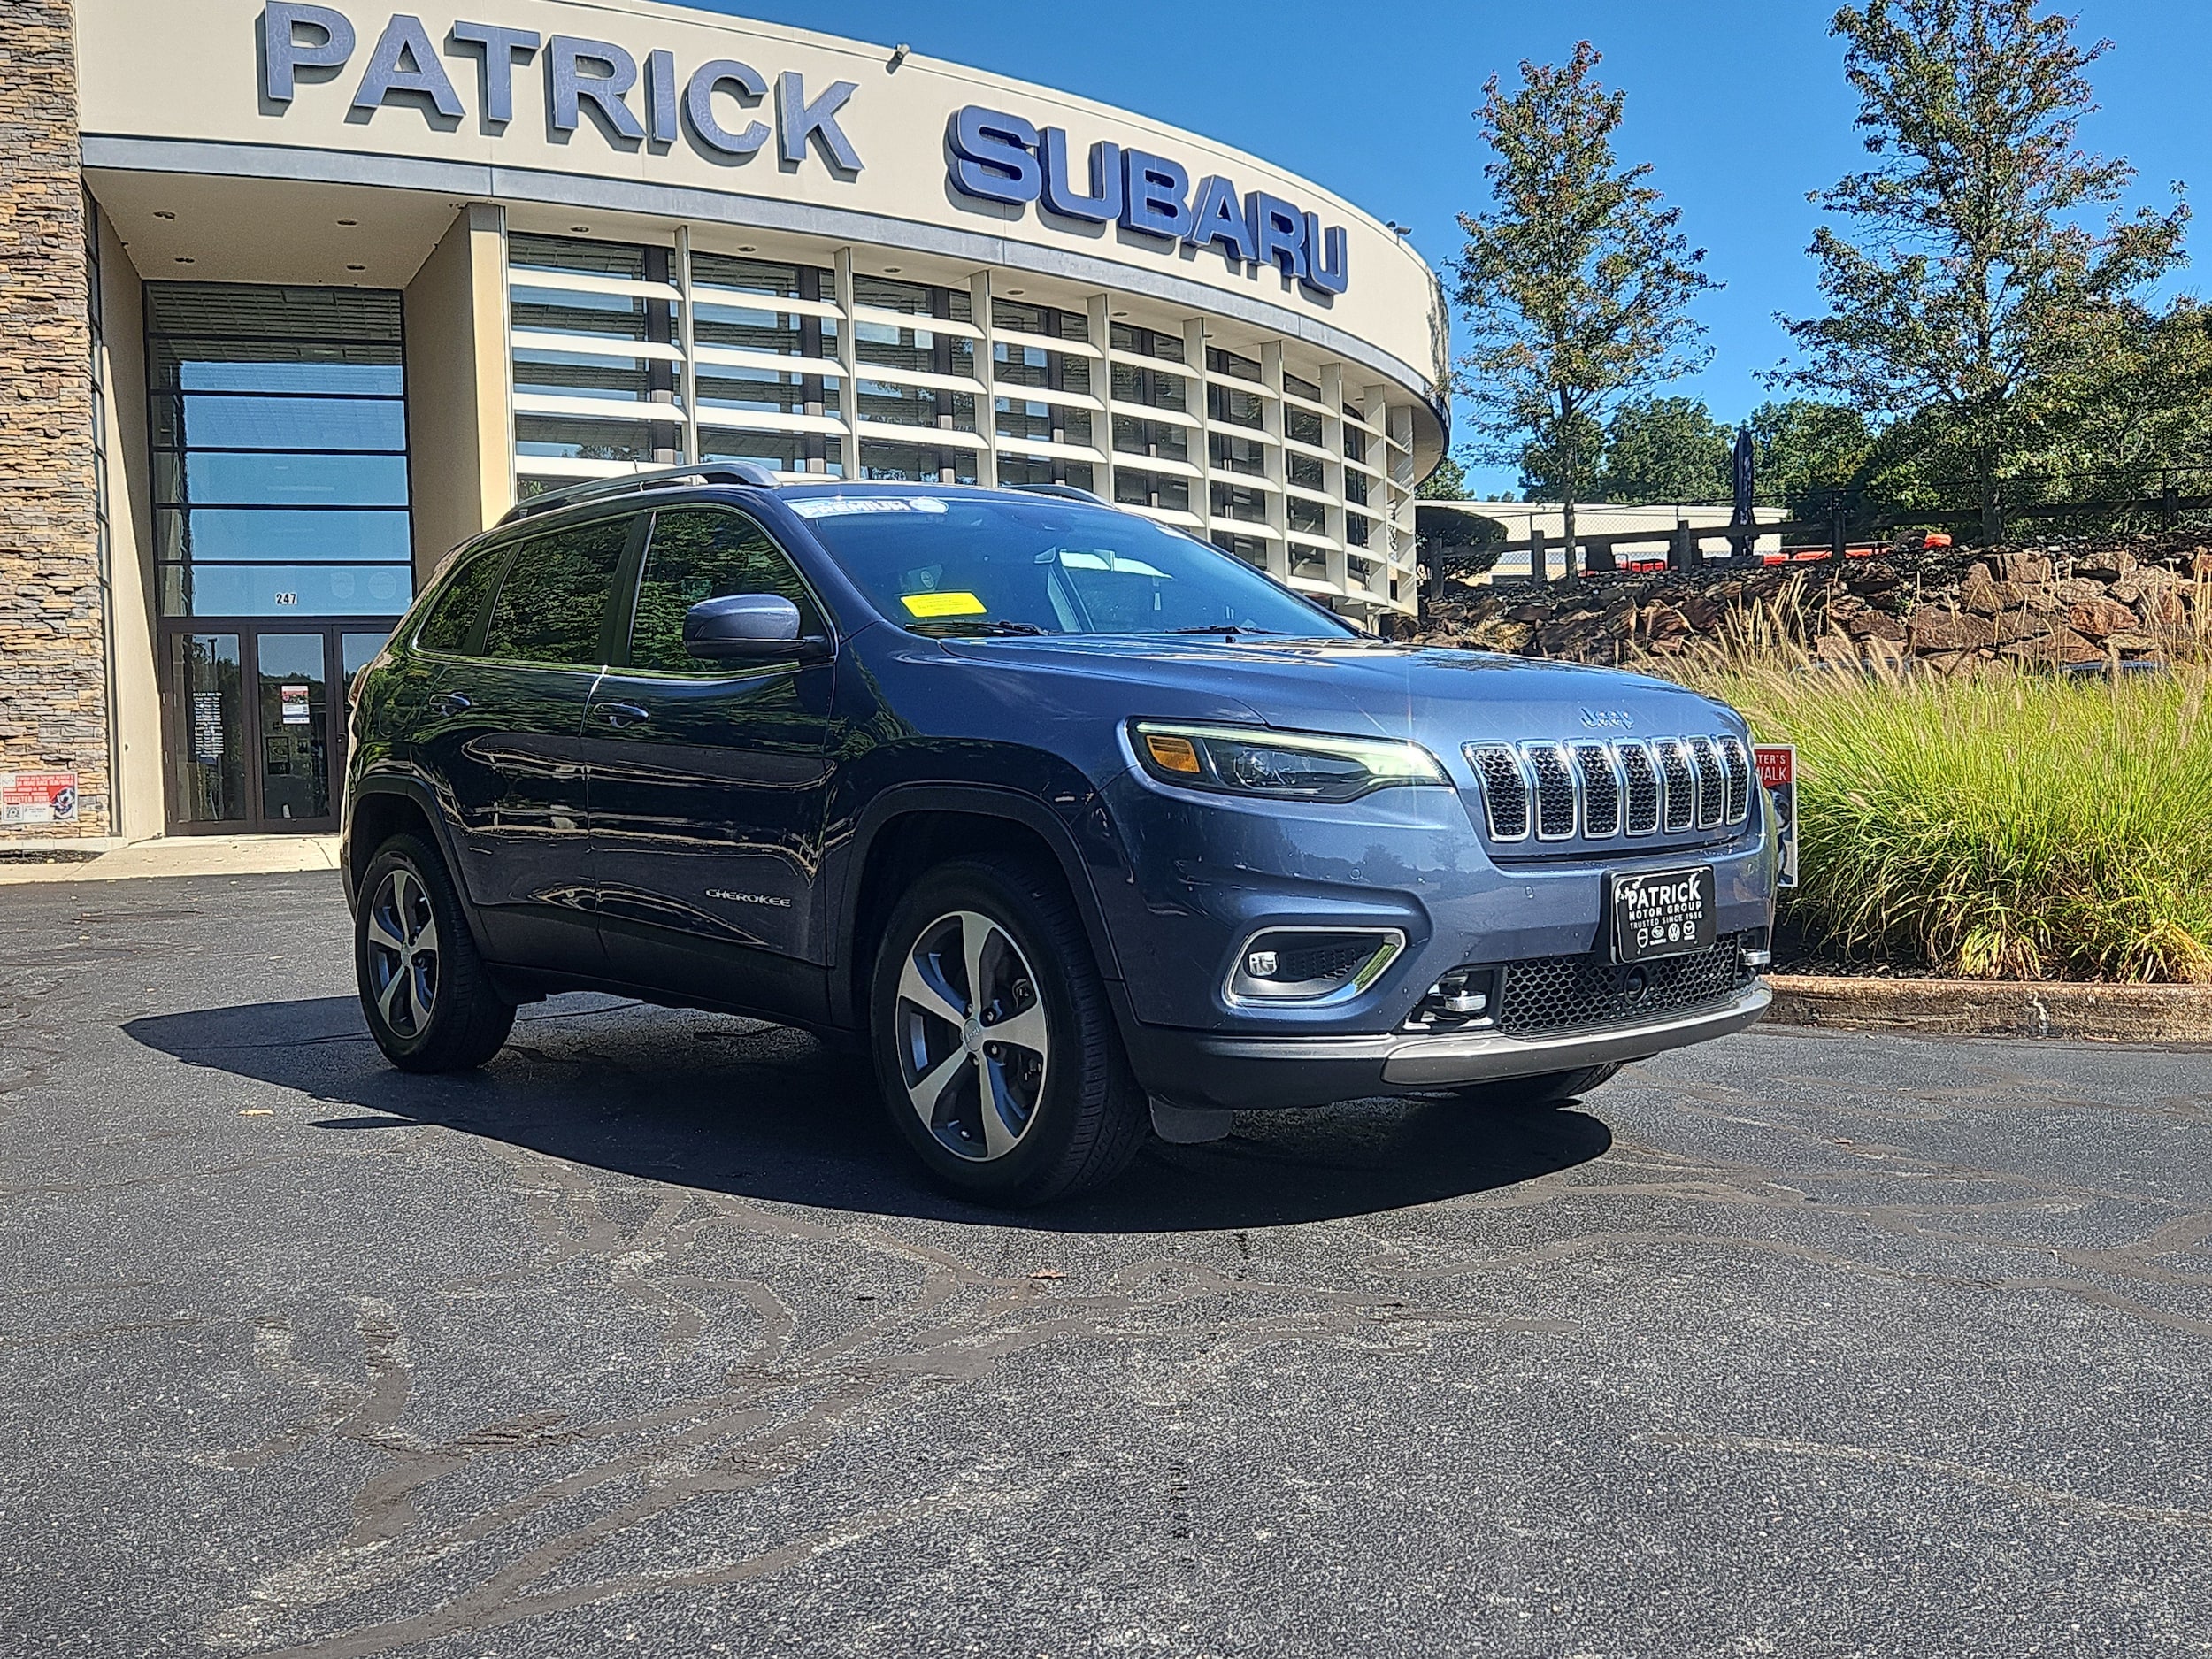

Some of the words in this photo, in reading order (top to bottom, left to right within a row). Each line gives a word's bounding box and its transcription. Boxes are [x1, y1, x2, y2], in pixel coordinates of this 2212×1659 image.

[263, 0, 865, 173] PATRICK
[948, 104, 1349, 296] SUBARU
[276, 593, 296, 605] 247
[1579, 707, 1635, 730] Jeep
[1756, 753, 1786, 764] TER'S
[705, 888, 792, 908] CHEROKEE
[1627, 879, 1701, 911] PATRICK
[1628, 906, 1663, 921] MOTOR
[1667, 900, 1702, 914] GROUP
[1630, 918, 1660, 930] TRUSTED
[1662, 914, 1684, 925] SINCE
